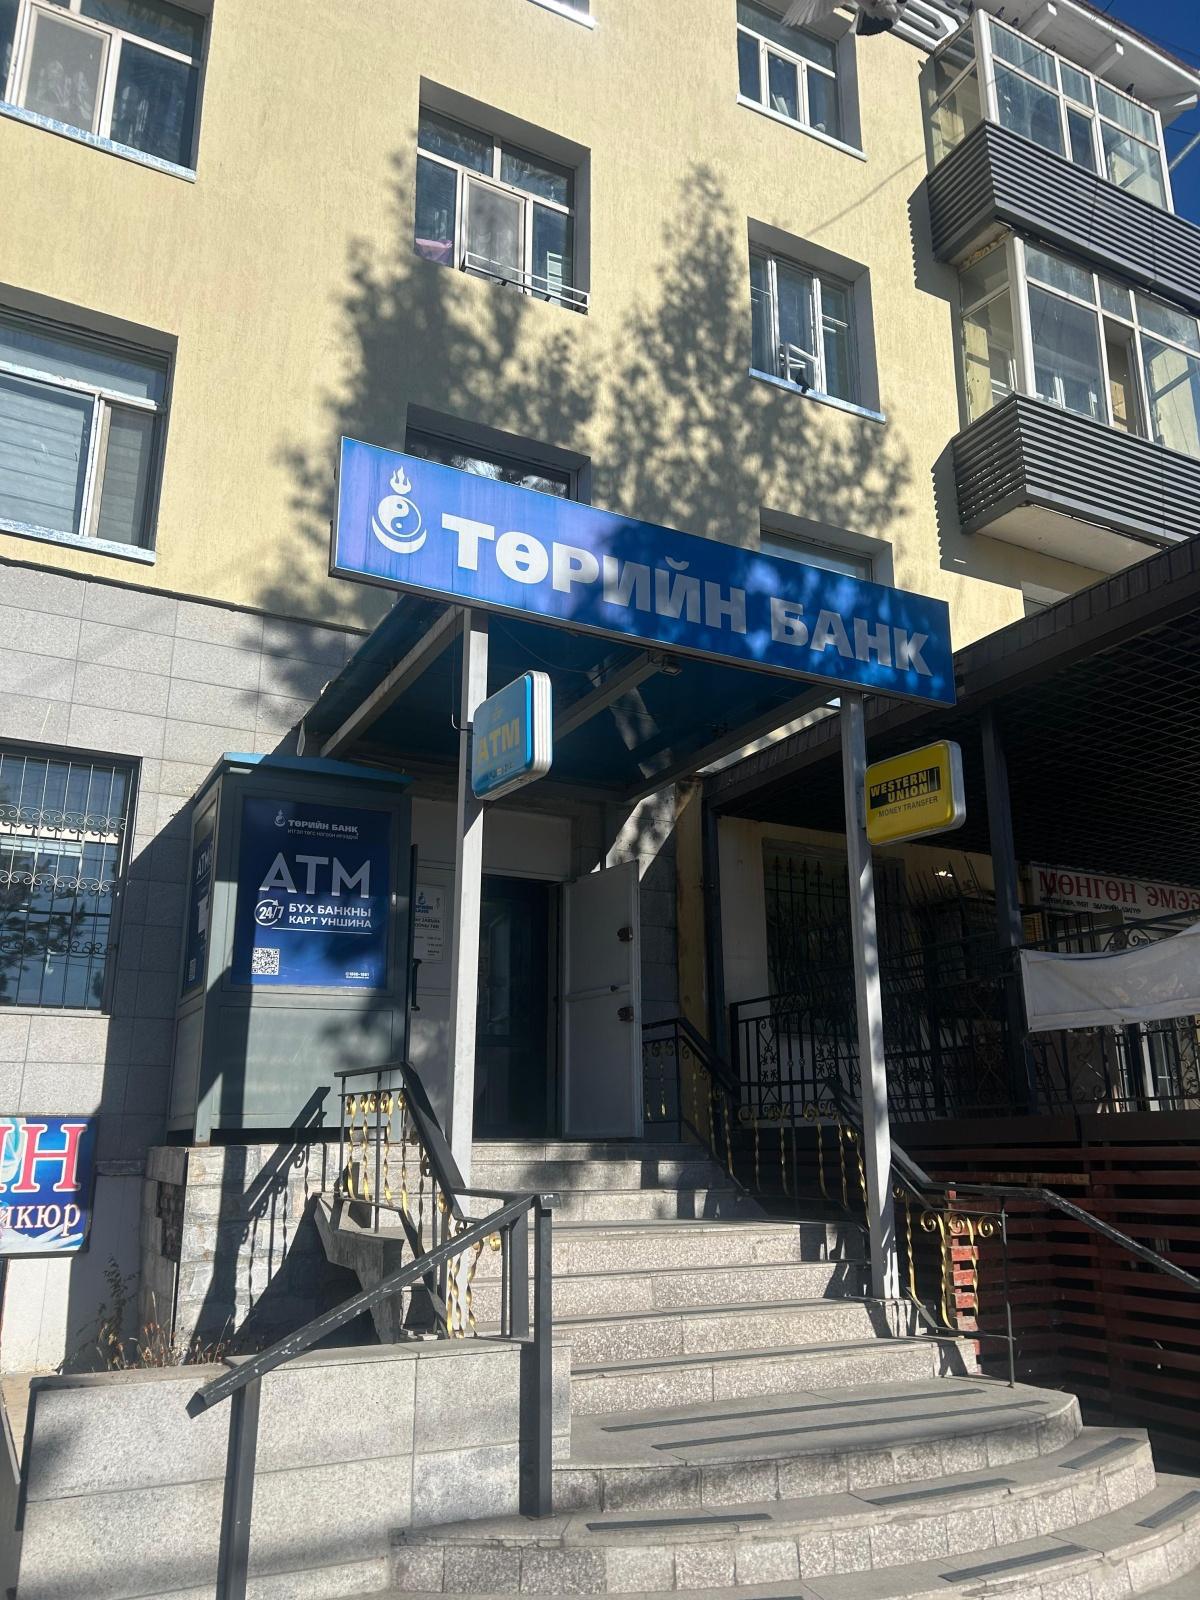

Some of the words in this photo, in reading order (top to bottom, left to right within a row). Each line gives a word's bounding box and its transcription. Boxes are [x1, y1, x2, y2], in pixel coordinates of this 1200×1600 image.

[442, 513, 749, 635] ТӨРИЙН
[770, 597, 934, 678] БАНК
[477, 717, 520, 762] ATM
[870, 770, 928, 798] WESTERN
[888, 782, 928, 803] UNION
[878, 806, 902, 817] MONEY
[903, 796, 938, 811] TRANSFER
[287, 819, 329, 831] ТӨРИЙН
[331, 824, 359, 833] БАНК
[258, 852, 371, 899] ATM
[1038, 871, 1137, 904] МӨНГӨН
[258, 905, 285, 920] 24/7
[288, 903, 314, 914] БҮХ
[317, 905, 372, 918] БАНКНЫ
[288, 915, 318, 925] КАРТ
[321, 917, 372, 928] УНШИНА
